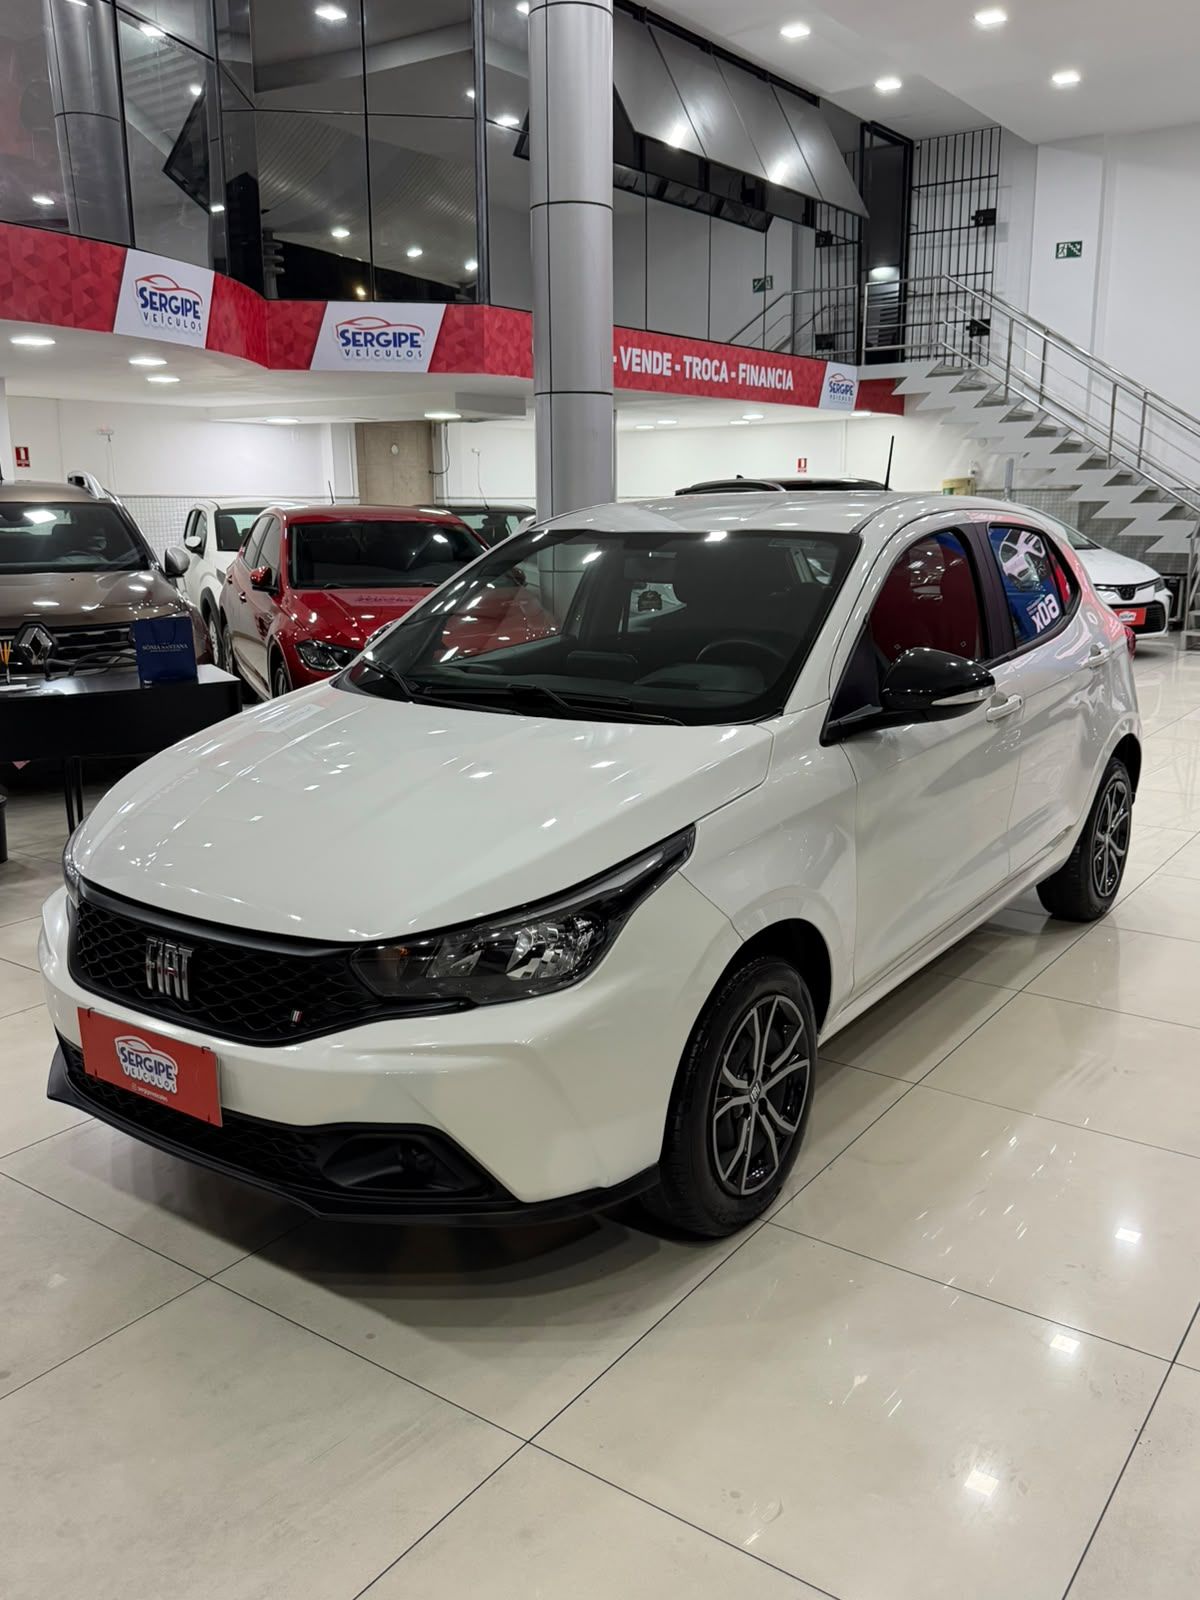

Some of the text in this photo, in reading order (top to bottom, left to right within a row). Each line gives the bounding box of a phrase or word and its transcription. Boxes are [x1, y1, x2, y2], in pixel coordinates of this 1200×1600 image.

[139, 286, 201, 320] SERGIPE
[143, 311, 202, 331] VEÍCULOS
[339, 328, 422, 349] SERGIPE
[344, 347, 422, 358] VEÍCULOS
[619, 345, 673, 377] VENDE
[683, 354, 729, 384] TROCA
[738, 363, 794, 391] FINANCIA
[146, 937, 194, 1001] FIAT
[119, 1046, 175, 1081] SERGIPE
